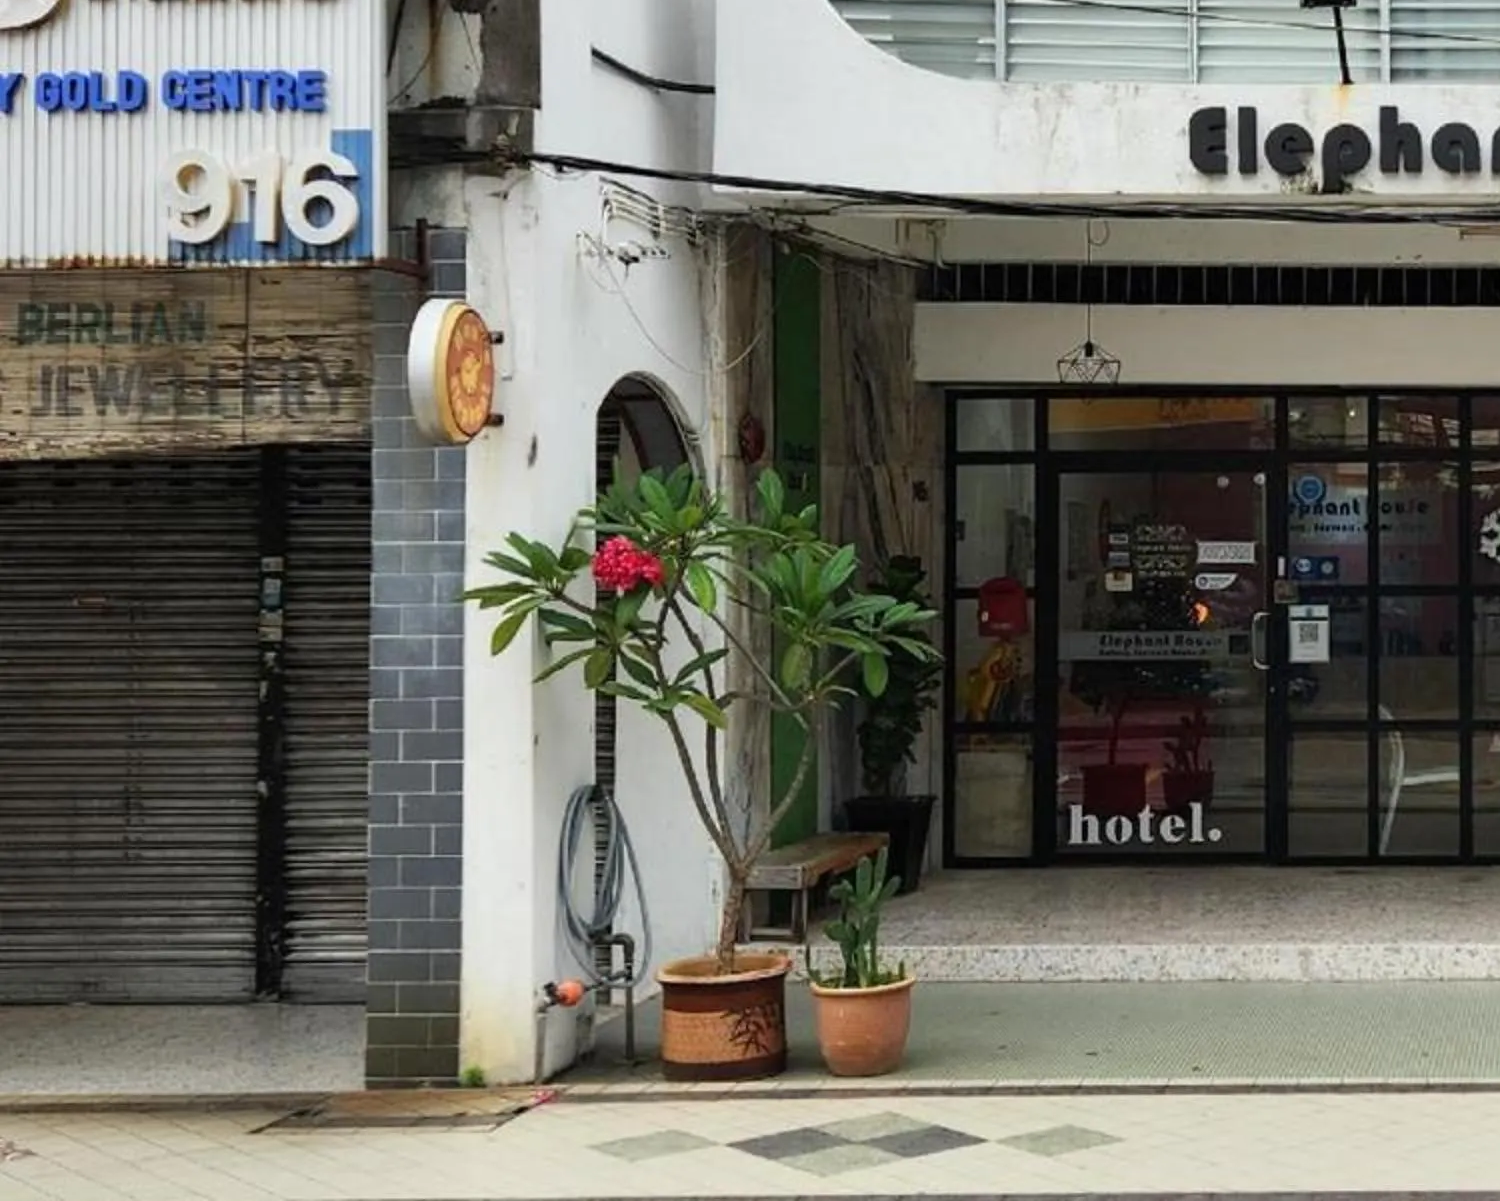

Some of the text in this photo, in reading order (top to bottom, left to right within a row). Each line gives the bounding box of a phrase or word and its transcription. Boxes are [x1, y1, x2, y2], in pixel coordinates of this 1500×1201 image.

[35, 71, 148, 112] GOLD
[161, 70, 327, 113] CENTRE
[160, 149, 360, 245] 916
[17, 301, 207, 345] BERLIAN
[1068, 802, 1222, 844] hotel.
